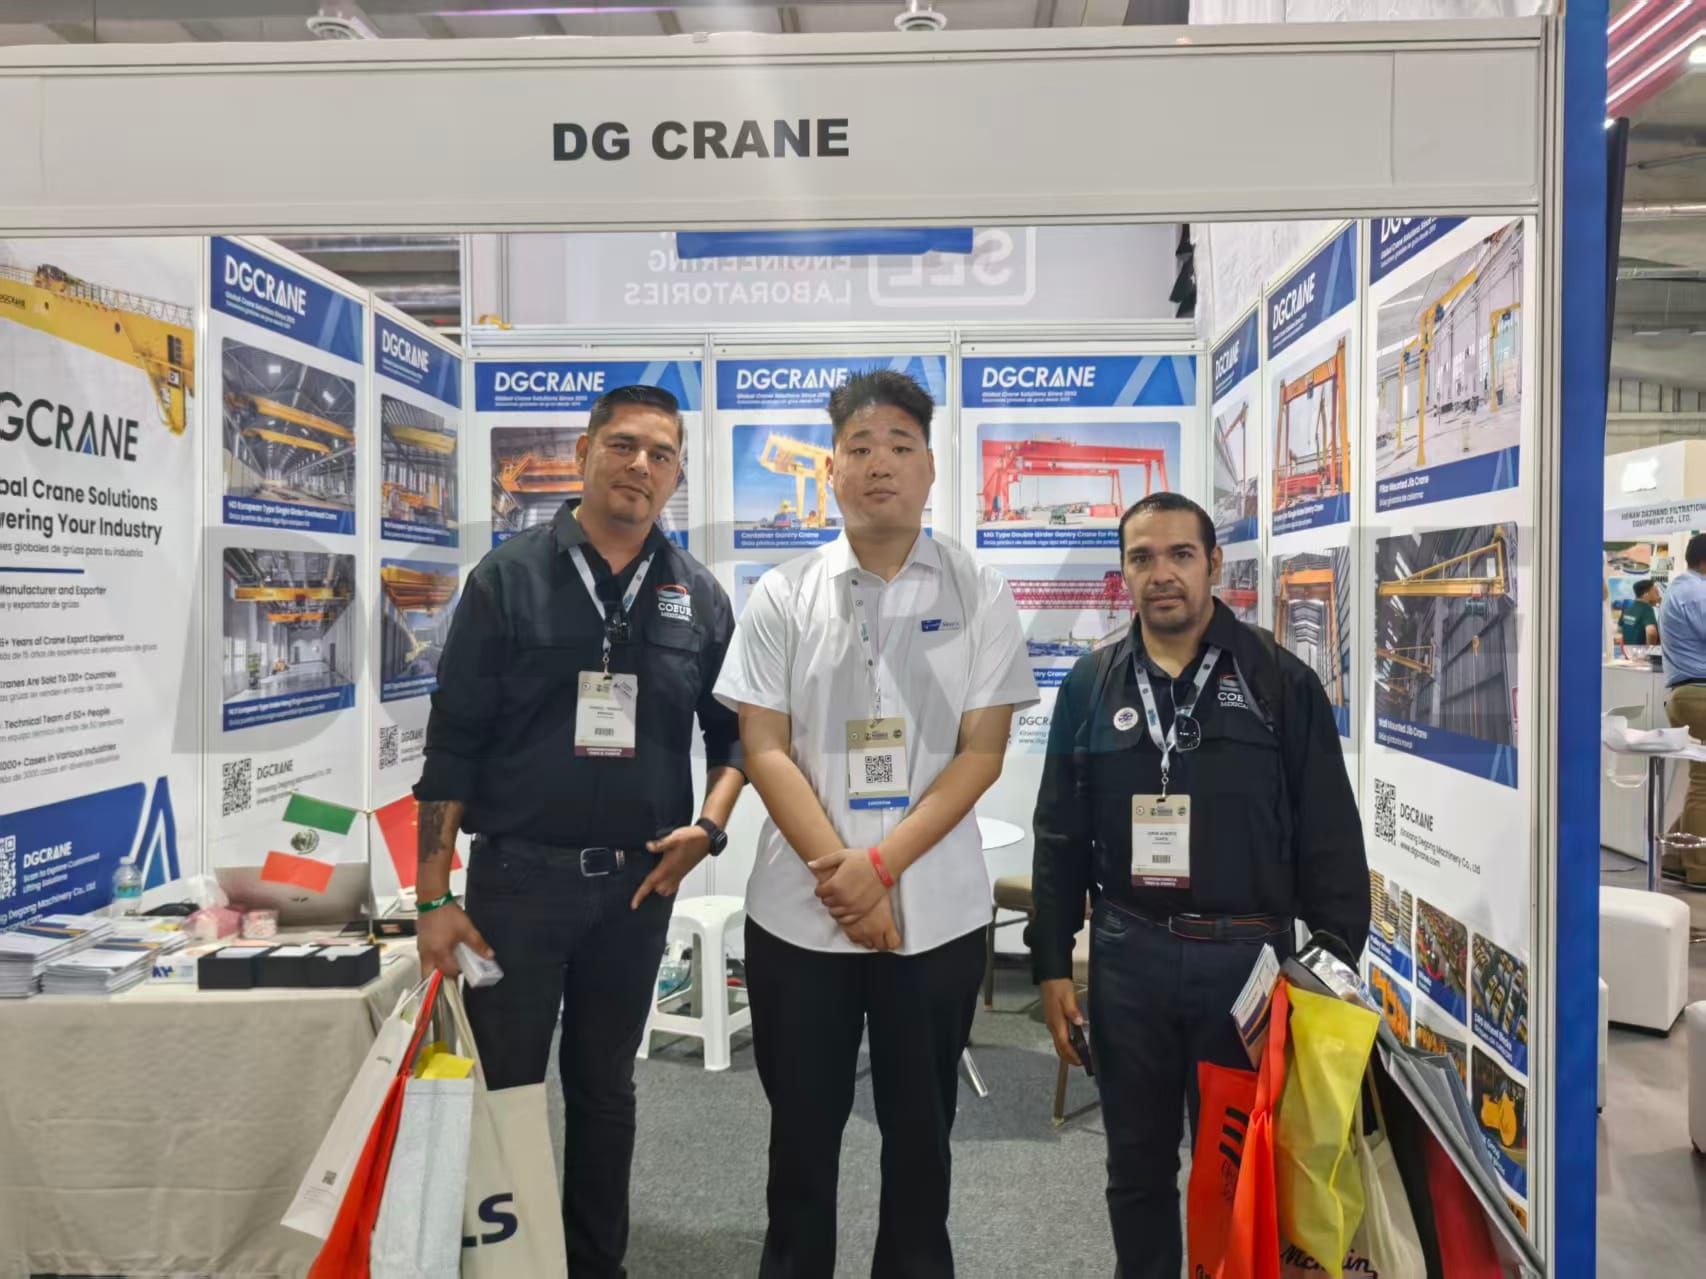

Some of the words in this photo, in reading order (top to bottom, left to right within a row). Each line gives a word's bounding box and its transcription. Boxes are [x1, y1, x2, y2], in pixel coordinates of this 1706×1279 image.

[552, 122, 630, 162] DG
[651, 118, 850, 160] CRANE
[224, 254, 307, 317] DGCRANE
[1273, 272, 1316, 331] DGCRANE
[382, 328, 430, 373] DGCRANE
[1215, 339, 1240, 380] DGCRANE
[494, 371, 605, 392] DGCRANE
[736, 367, 848, 390] DGCRANE
[981, 365, 1096, 388] DGCRANE
[0, 391, 139, 461] GCRANE
[32, 479, 85, 503] Crane
[88, 486, 158, 512] Solutions
[57, 513, 96, 535] Your
[99, 516, 162, 546] Industry
[798, 531, 819, 539] Crane
[995, 531, 1011, 540] Type
[1055, 531, 1076, 540] Gantry
[58, 586, 75, 596] and
[76, 586, 107, 598] Exporter
[658, 602, 692, 617] COEUR
[11, 637, 33, 648] Years
[26, 676, 40, 687] Are
[43, 713, 64, 725] Team
[1019, 716, 1049, 725] DGCR
[23, 755, 47, 767] Cases
[257, 759, 293, 780] DGCRANE
[1400, 802, 1433, 832] DGCRANE
[23, 841, 72, 868] DGCRANE
